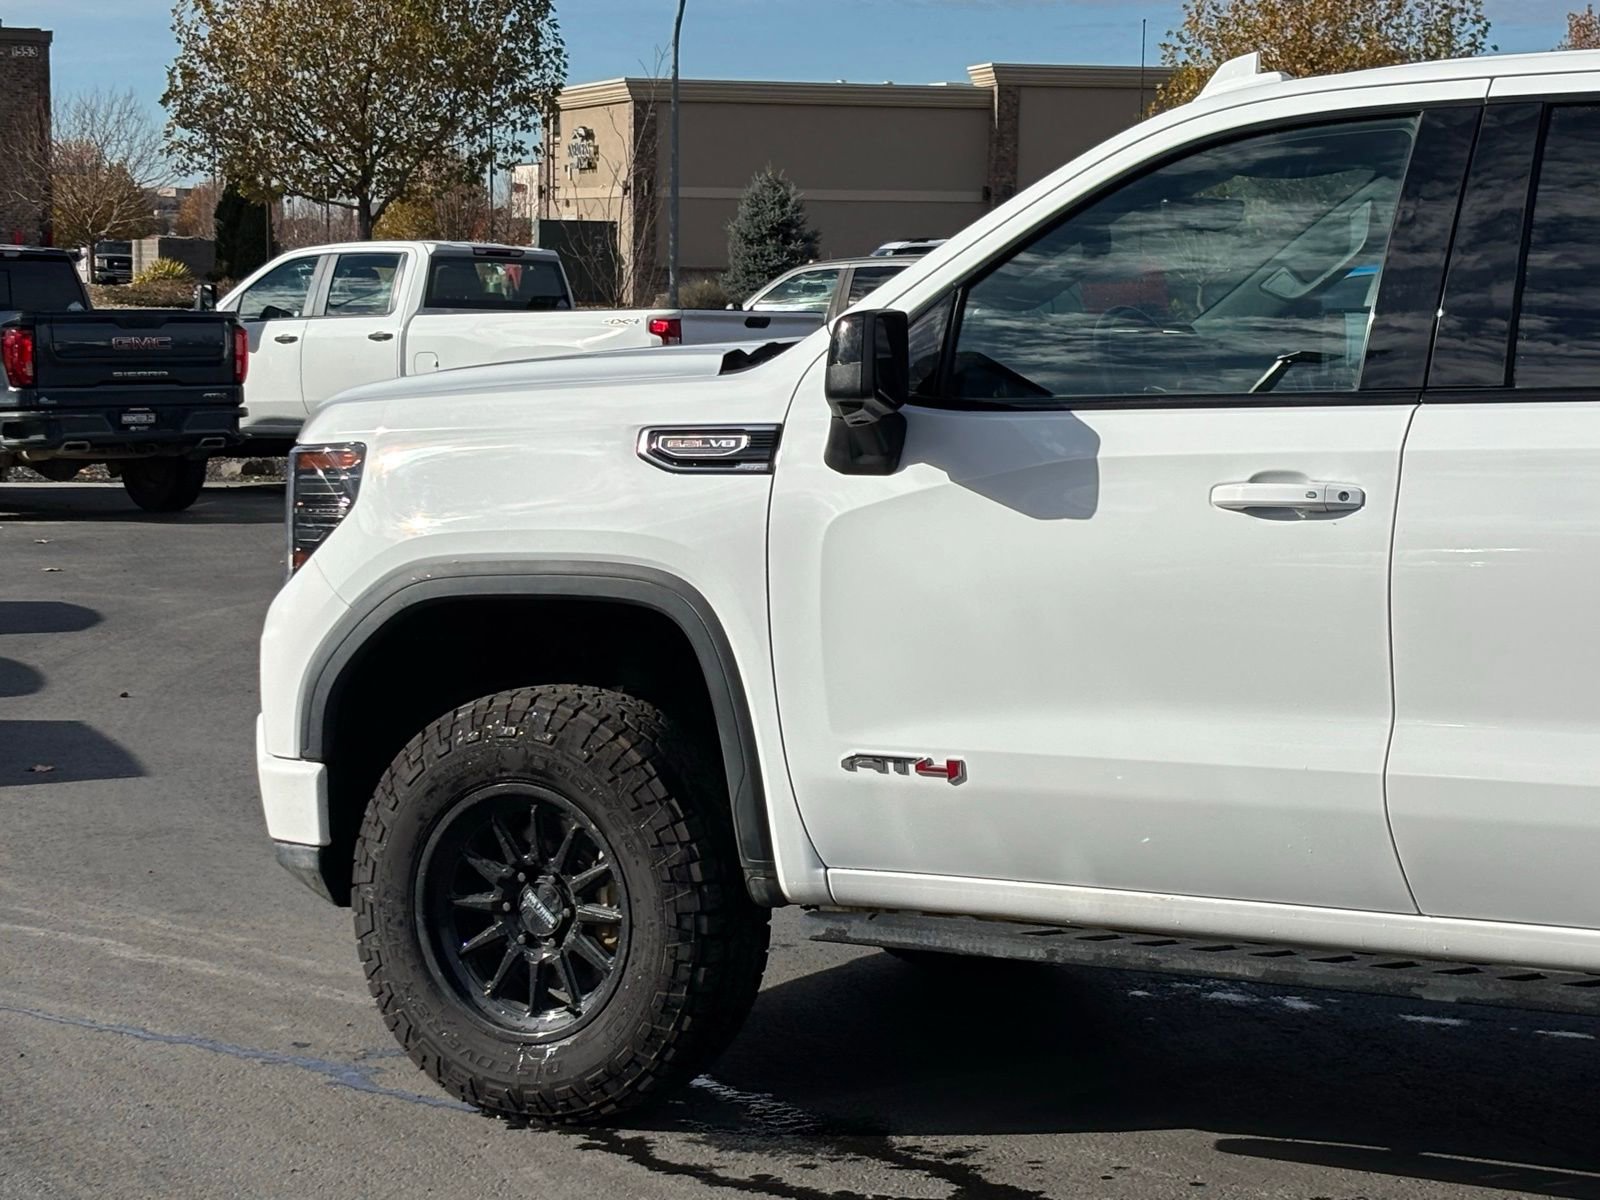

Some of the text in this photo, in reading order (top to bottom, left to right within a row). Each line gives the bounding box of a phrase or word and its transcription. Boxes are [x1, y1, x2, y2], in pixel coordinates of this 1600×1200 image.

[11, 45, 39, 57] 1553
[111, 336, 172, 350] GMC
[841, 753, 967, 786] AT4
